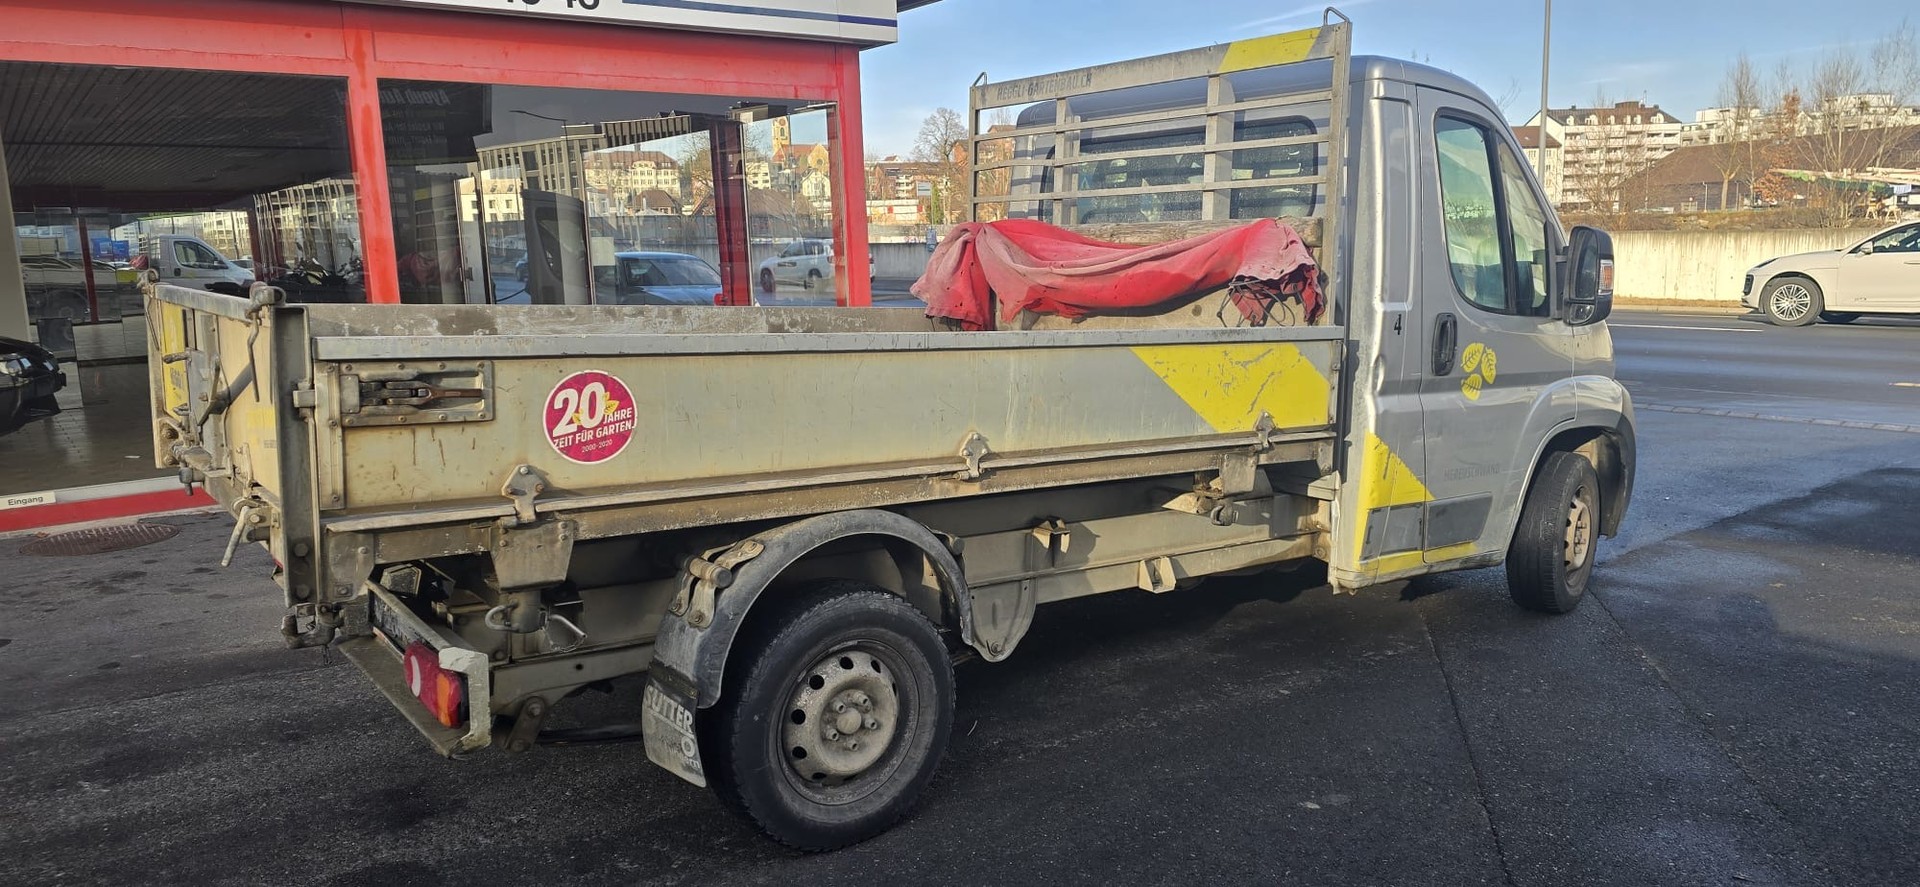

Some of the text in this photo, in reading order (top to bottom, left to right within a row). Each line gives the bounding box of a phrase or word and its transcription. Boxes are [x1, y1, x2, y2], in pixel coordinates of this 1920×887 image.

[1394, 313, 1402, 336] 4
[552, 382, 633, 438] 20 JAHRE
[553, 435, 575, 449] ZEIT
[575, 429, 594, 444] FÜR
[8, 496, 44, 506] Eingang
[645, 684, 694, 734] SUTTER
